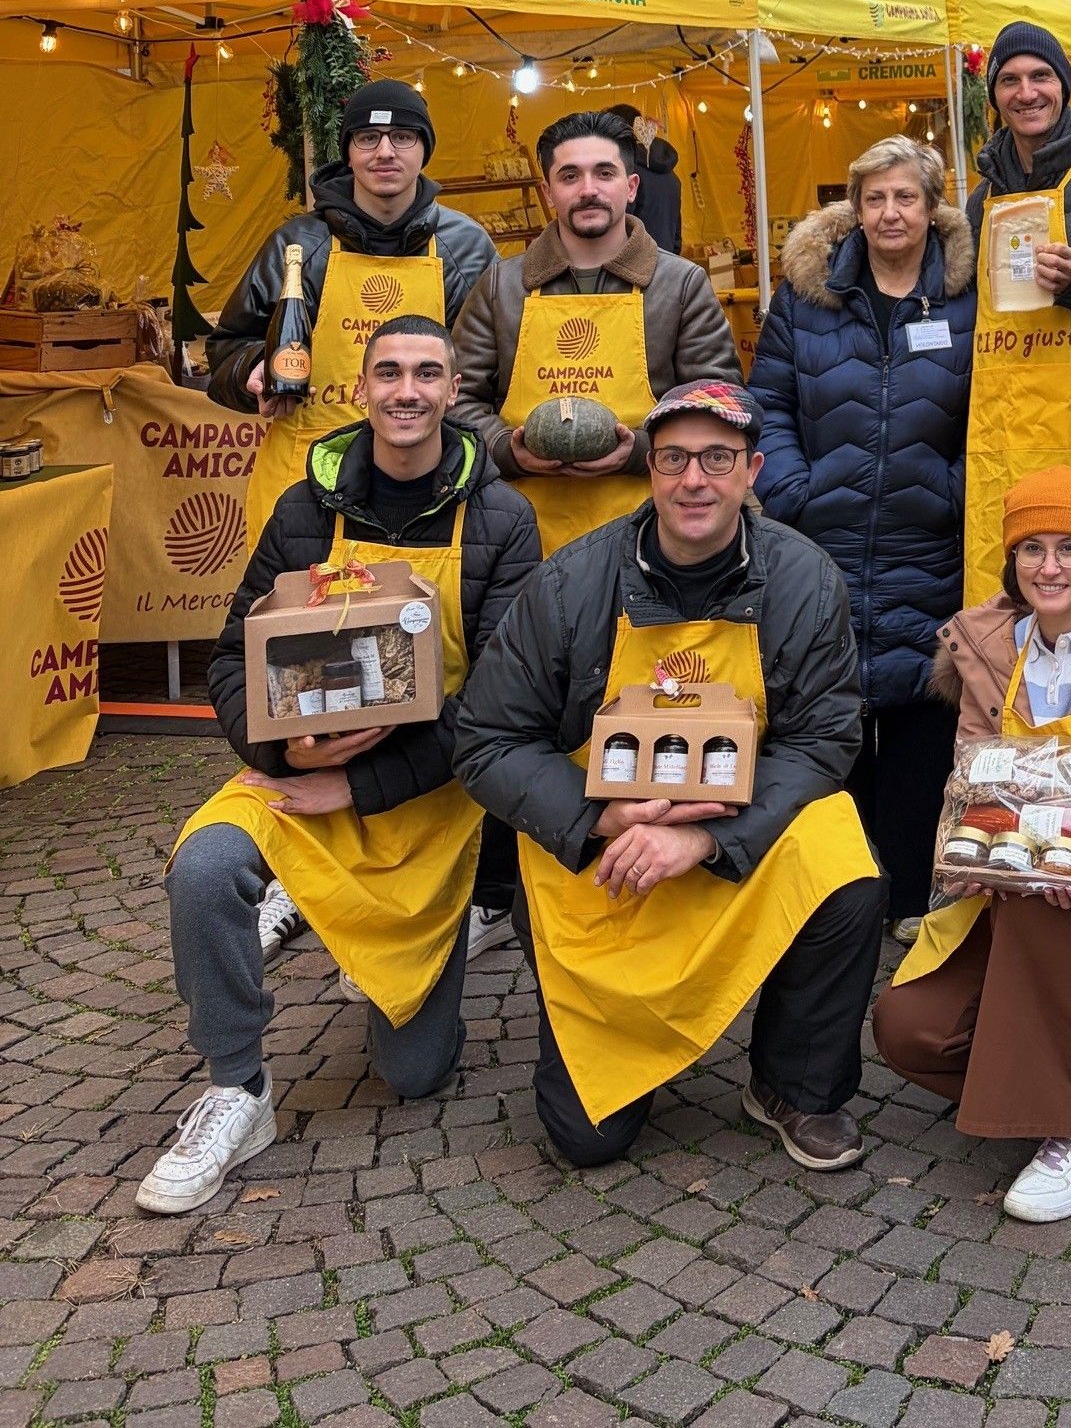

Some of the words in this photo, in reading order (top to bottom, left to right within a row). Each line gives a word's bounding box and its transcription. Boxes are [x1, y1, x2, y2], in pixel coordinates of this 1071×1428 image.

[858, 63, 936, 80] CREMONA
[282, 357, 307, 369] TOR
[538, 366, 614, 380] CAMPAGNA
[549, 380, 599, 394] AMICA
[140, 421, 273, 448] CAMPAGN
[136, 591, 154, 612] Il
